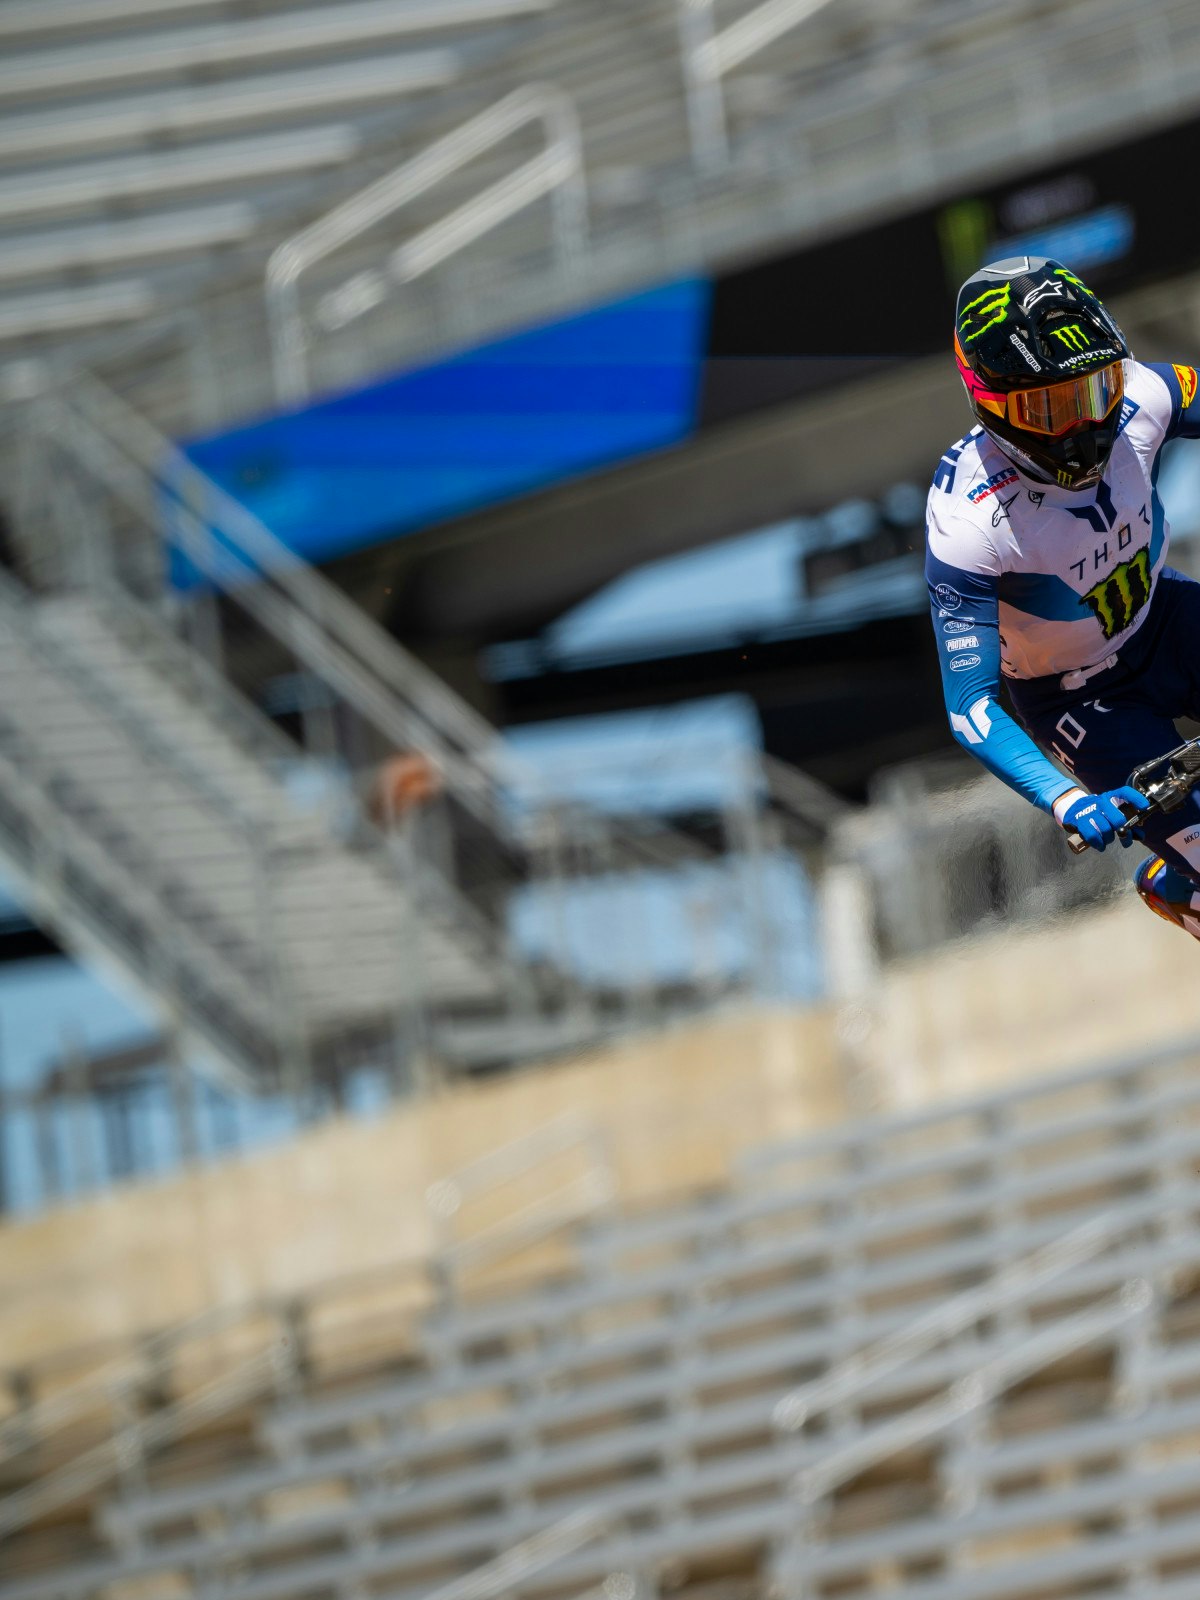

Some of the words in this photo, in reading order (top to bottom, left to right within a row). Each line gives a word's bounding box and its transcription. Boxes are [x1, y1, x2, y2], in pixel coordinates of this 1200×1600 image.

[1058, 348, 1117, 369] MONSTER
[966, 467, 1017, 501] PARTS
[1074, 803, 1097, 820] THOR
